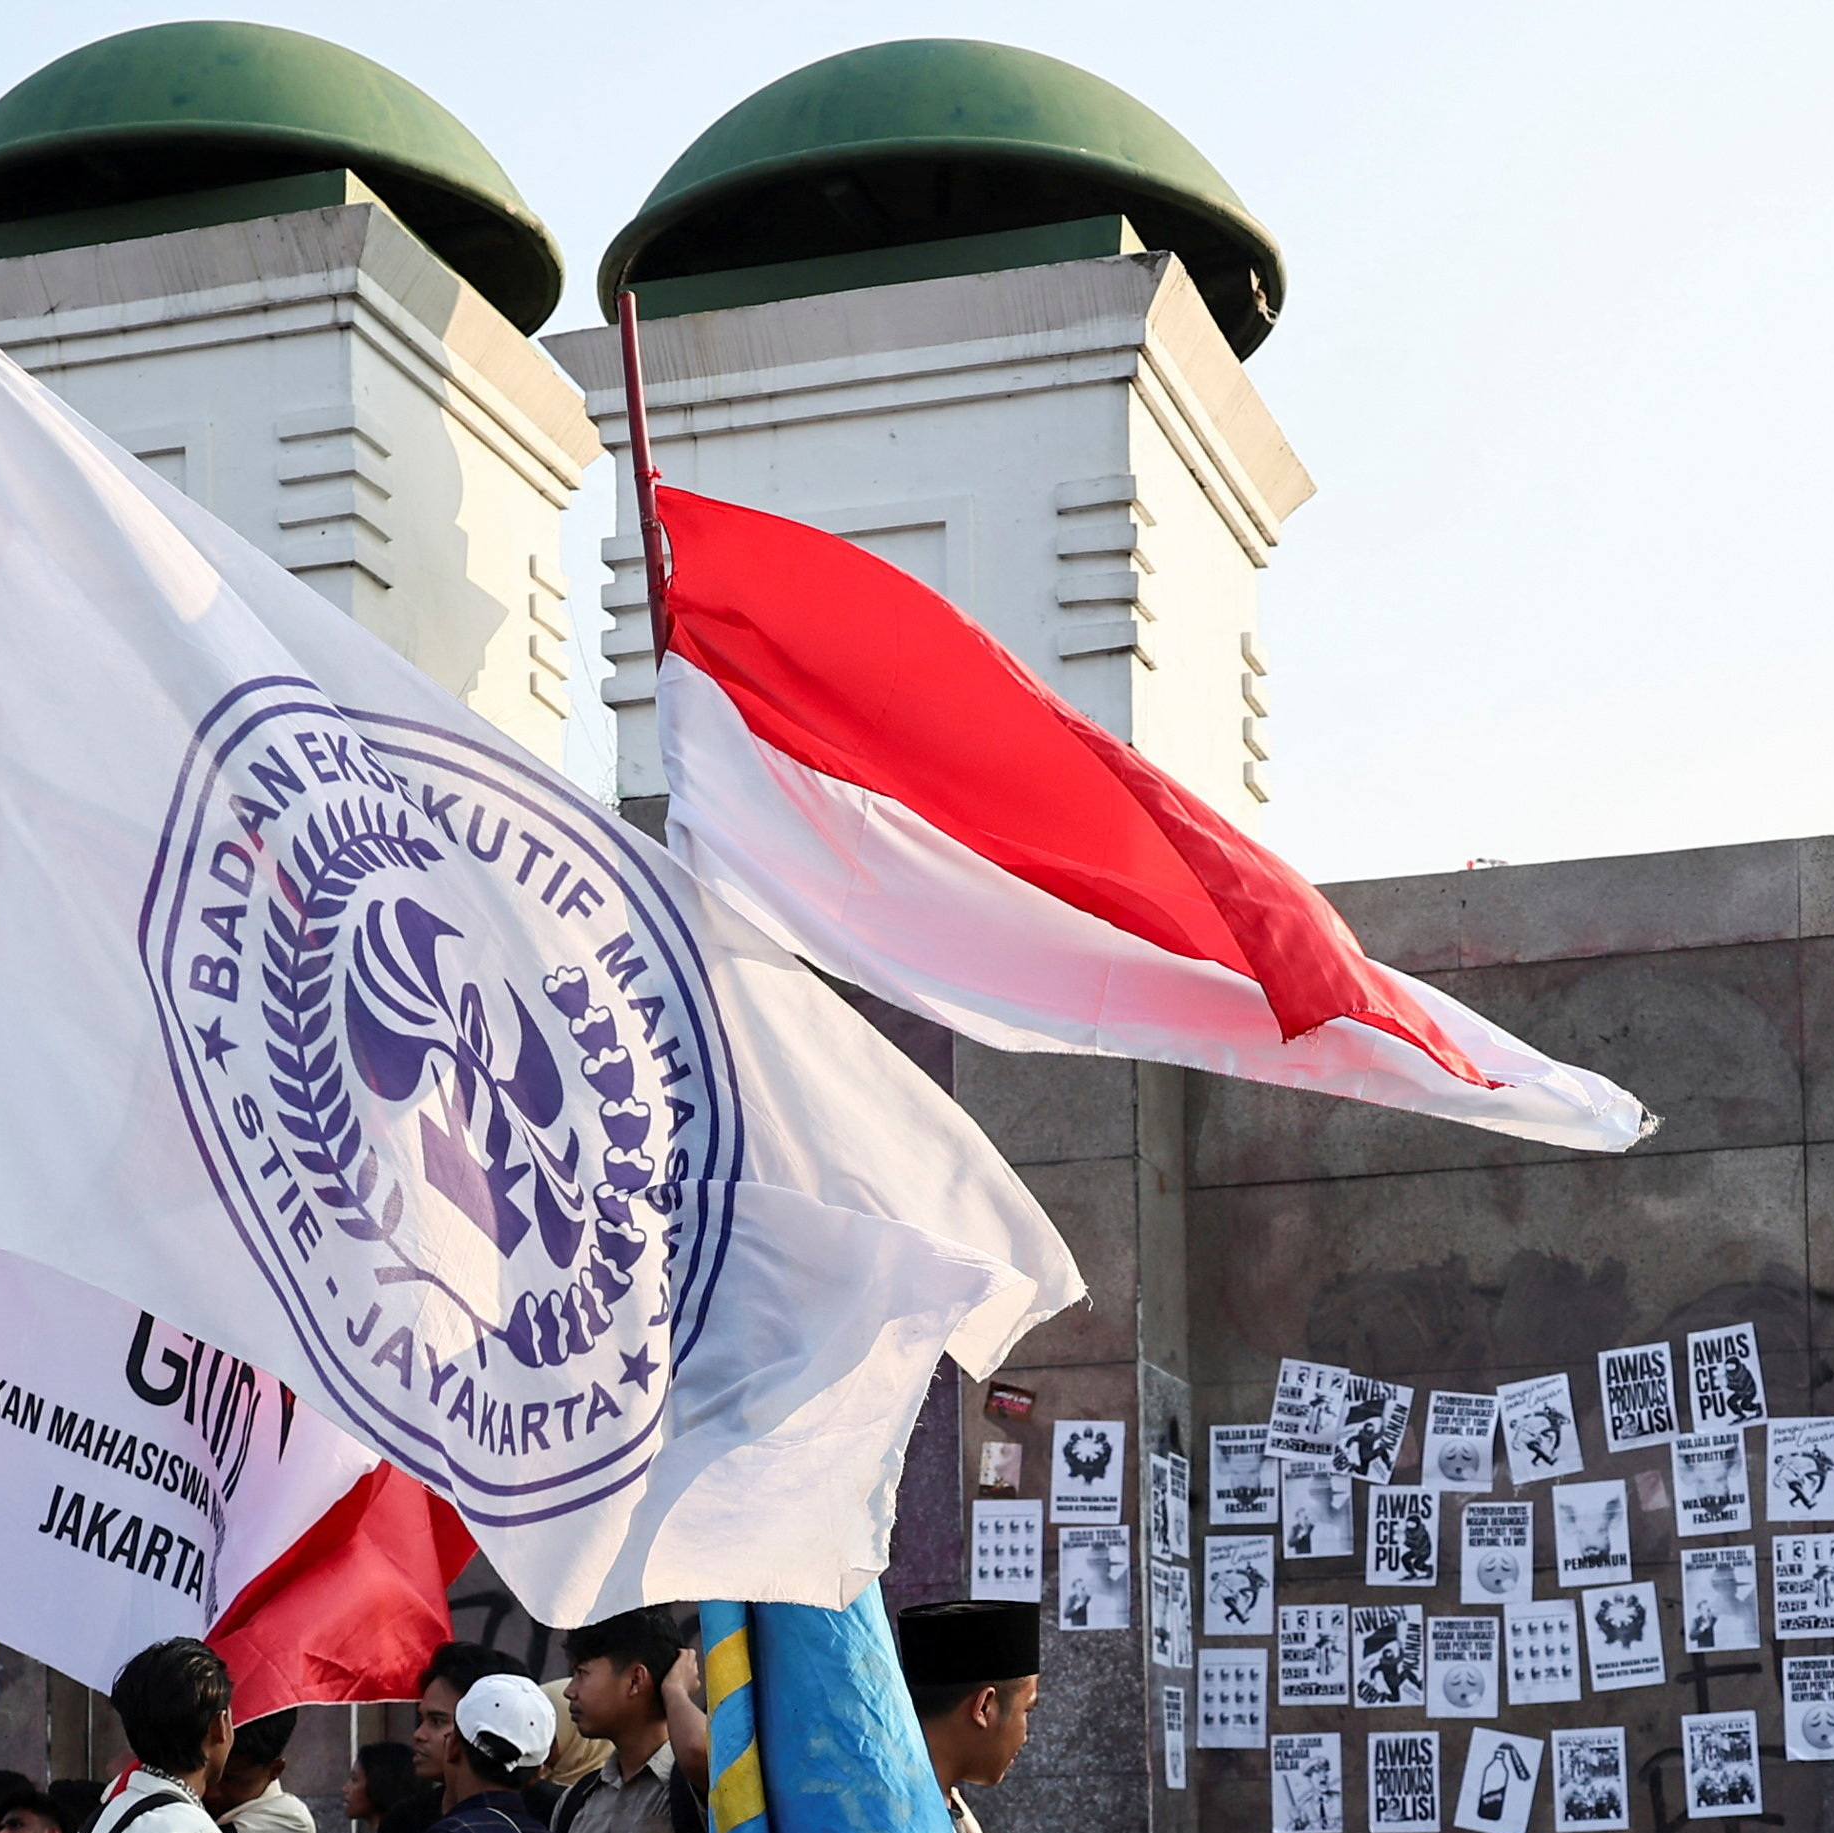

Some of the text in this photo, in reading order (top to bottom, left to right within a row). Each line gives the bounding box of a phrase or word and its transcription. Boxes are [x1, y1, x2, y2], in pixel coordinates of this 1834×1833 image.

[189, 738, 310, 1006] BADAN
[233, 1092, 318, 1266] STIE
[345, 1302, 624, 1459] JAYAKARTA
[1693, 1332, 1750, 1368] AWAS
[1606, 1350, 1666, 1385] AWAS
[1695, 1366, 1720, 1394] CE
[1608, 1378, 1667, 1415] PROVOKASI
[1698, 1391, 1726, 1421] PU
[1380, 1403, 1408, 1450] KANAN
[1375, 1494, 1432, 1519] AWAS
[39, 1484, 206, 1604] JAKARTA
[1375, 1521, 1398, 1545] CE
[1375, 1547, 1400, 1572] PU
[1354, 1606, 1407, 1634] AWAS!
[1403, 1622, 1421, 1671] KANAN
[1375, 1738, 1433, 1767] AWAS
[1375, 1766, 1434, 1797] PROVOKASI
